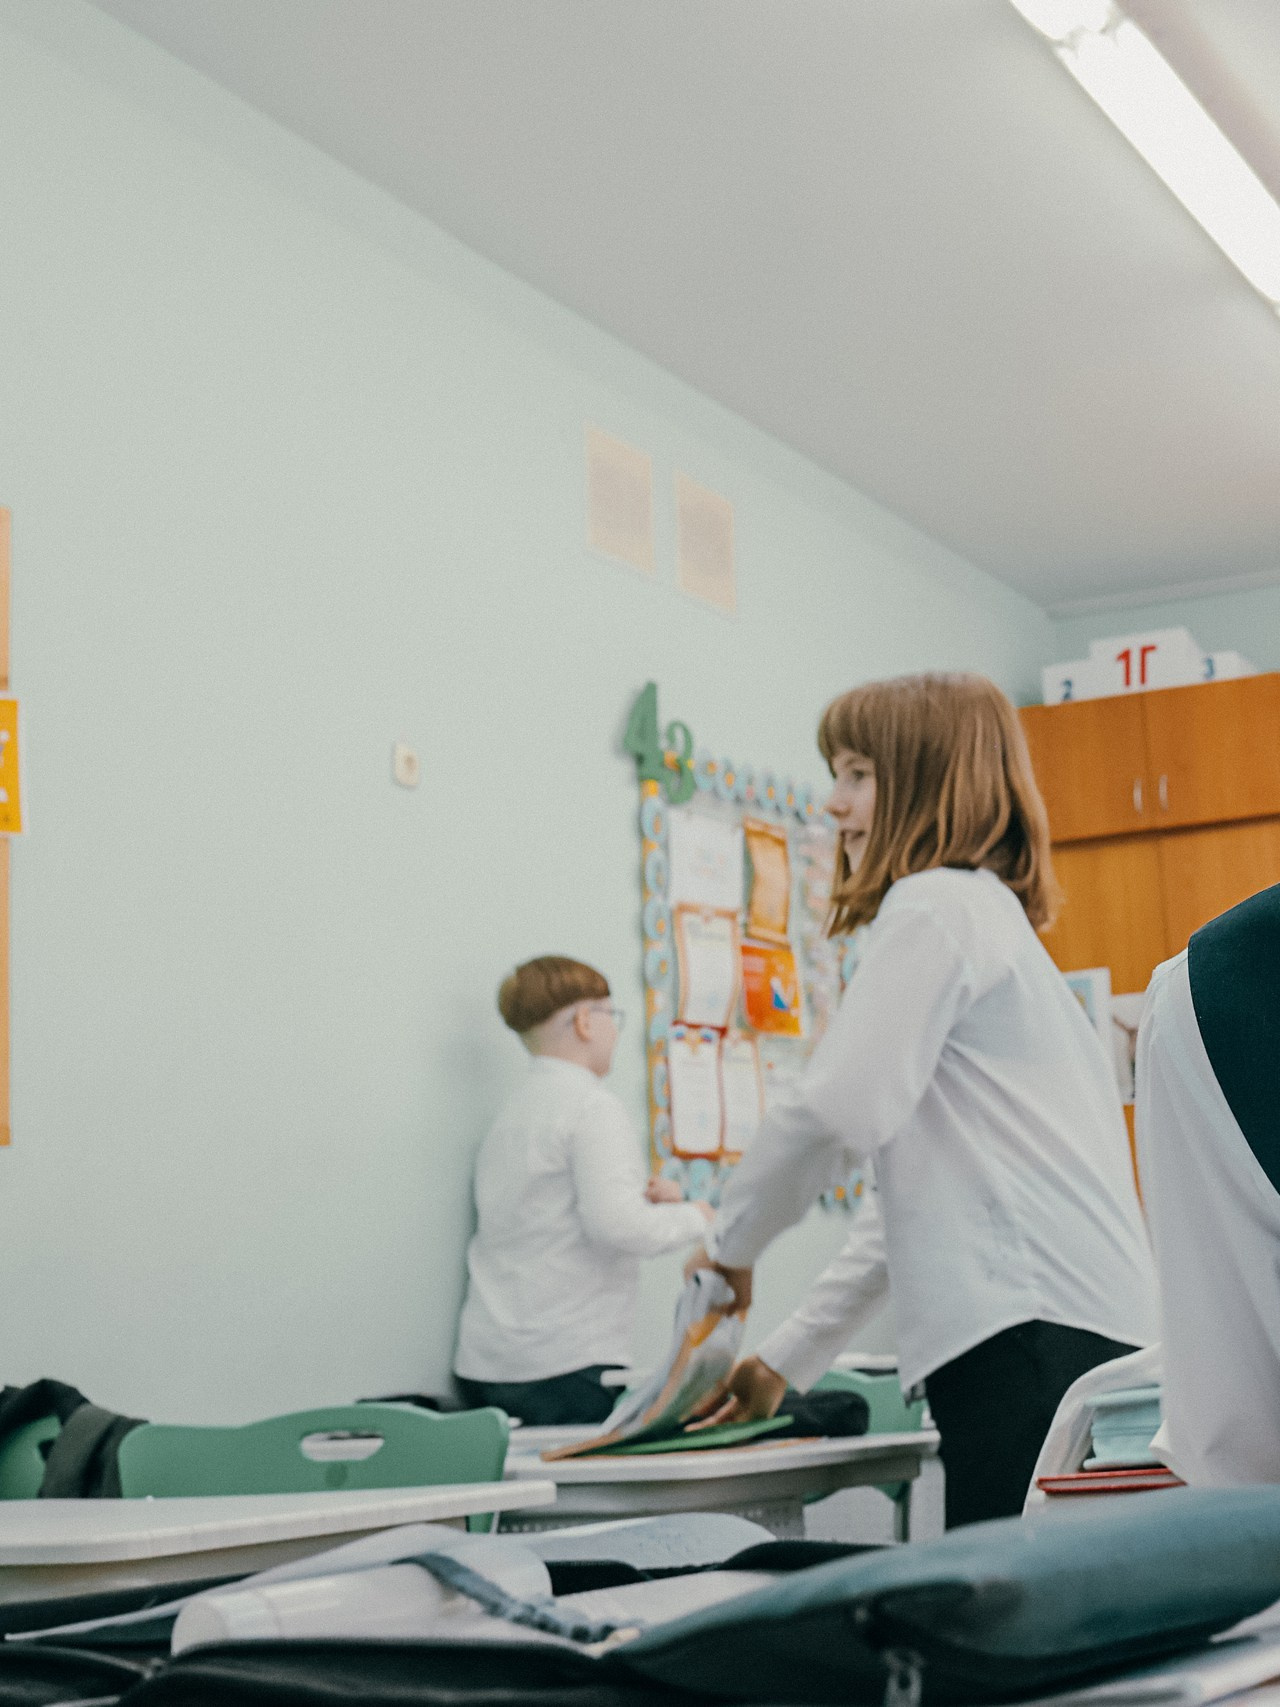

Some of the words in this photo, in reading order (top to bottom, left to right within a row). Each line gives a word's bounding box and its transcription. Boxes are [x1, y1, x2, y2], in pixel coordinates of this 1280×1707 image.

[1116, 645, 1158, 686] 1Г
[1204, 656, 1216, 680] 3
[1062, 678, 1074, 701] 2
